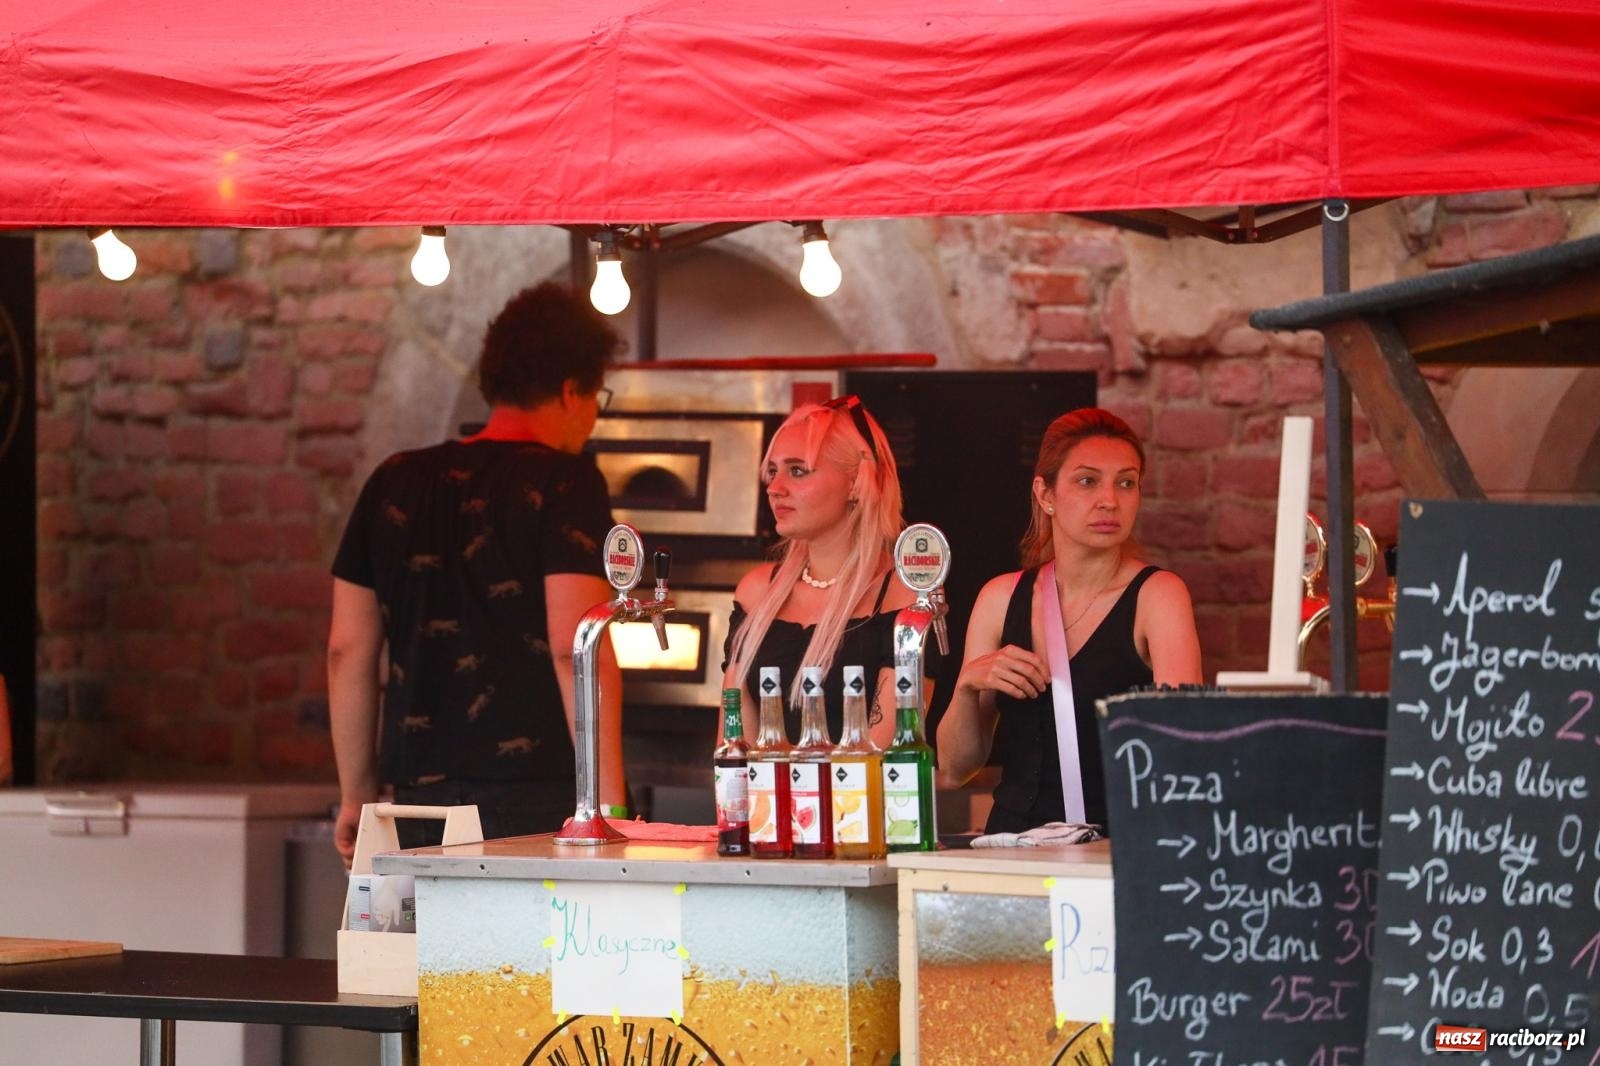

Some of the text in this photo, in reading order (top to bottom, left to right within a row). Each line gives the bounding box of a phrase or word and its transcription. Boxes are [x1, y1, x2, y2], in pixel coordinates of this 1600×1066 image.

[1443, 551, 1562, 644] Aperol
[1431, 689, 1600, 763] Mojito 2
[1427, 755, 1589, 802] Cuba libre
[1206, 809, 1382, 876] Margherit
[1427, 804, 1600, 877] Whisky 0,
[1203, 868, 1323, 933] Szynka
[1421, 857, 1488, 904] Piwo
[1502, 868, 1574, 909] lane
[1202, 919, 1322, 964] Salami
[1426, 914, 1487, 963] Sok
[1501, 926, 1554, 975] 0,3
[1127, 976, 1252, 1041] Burger
[1523, 983, 1590, 1028] 0,5
